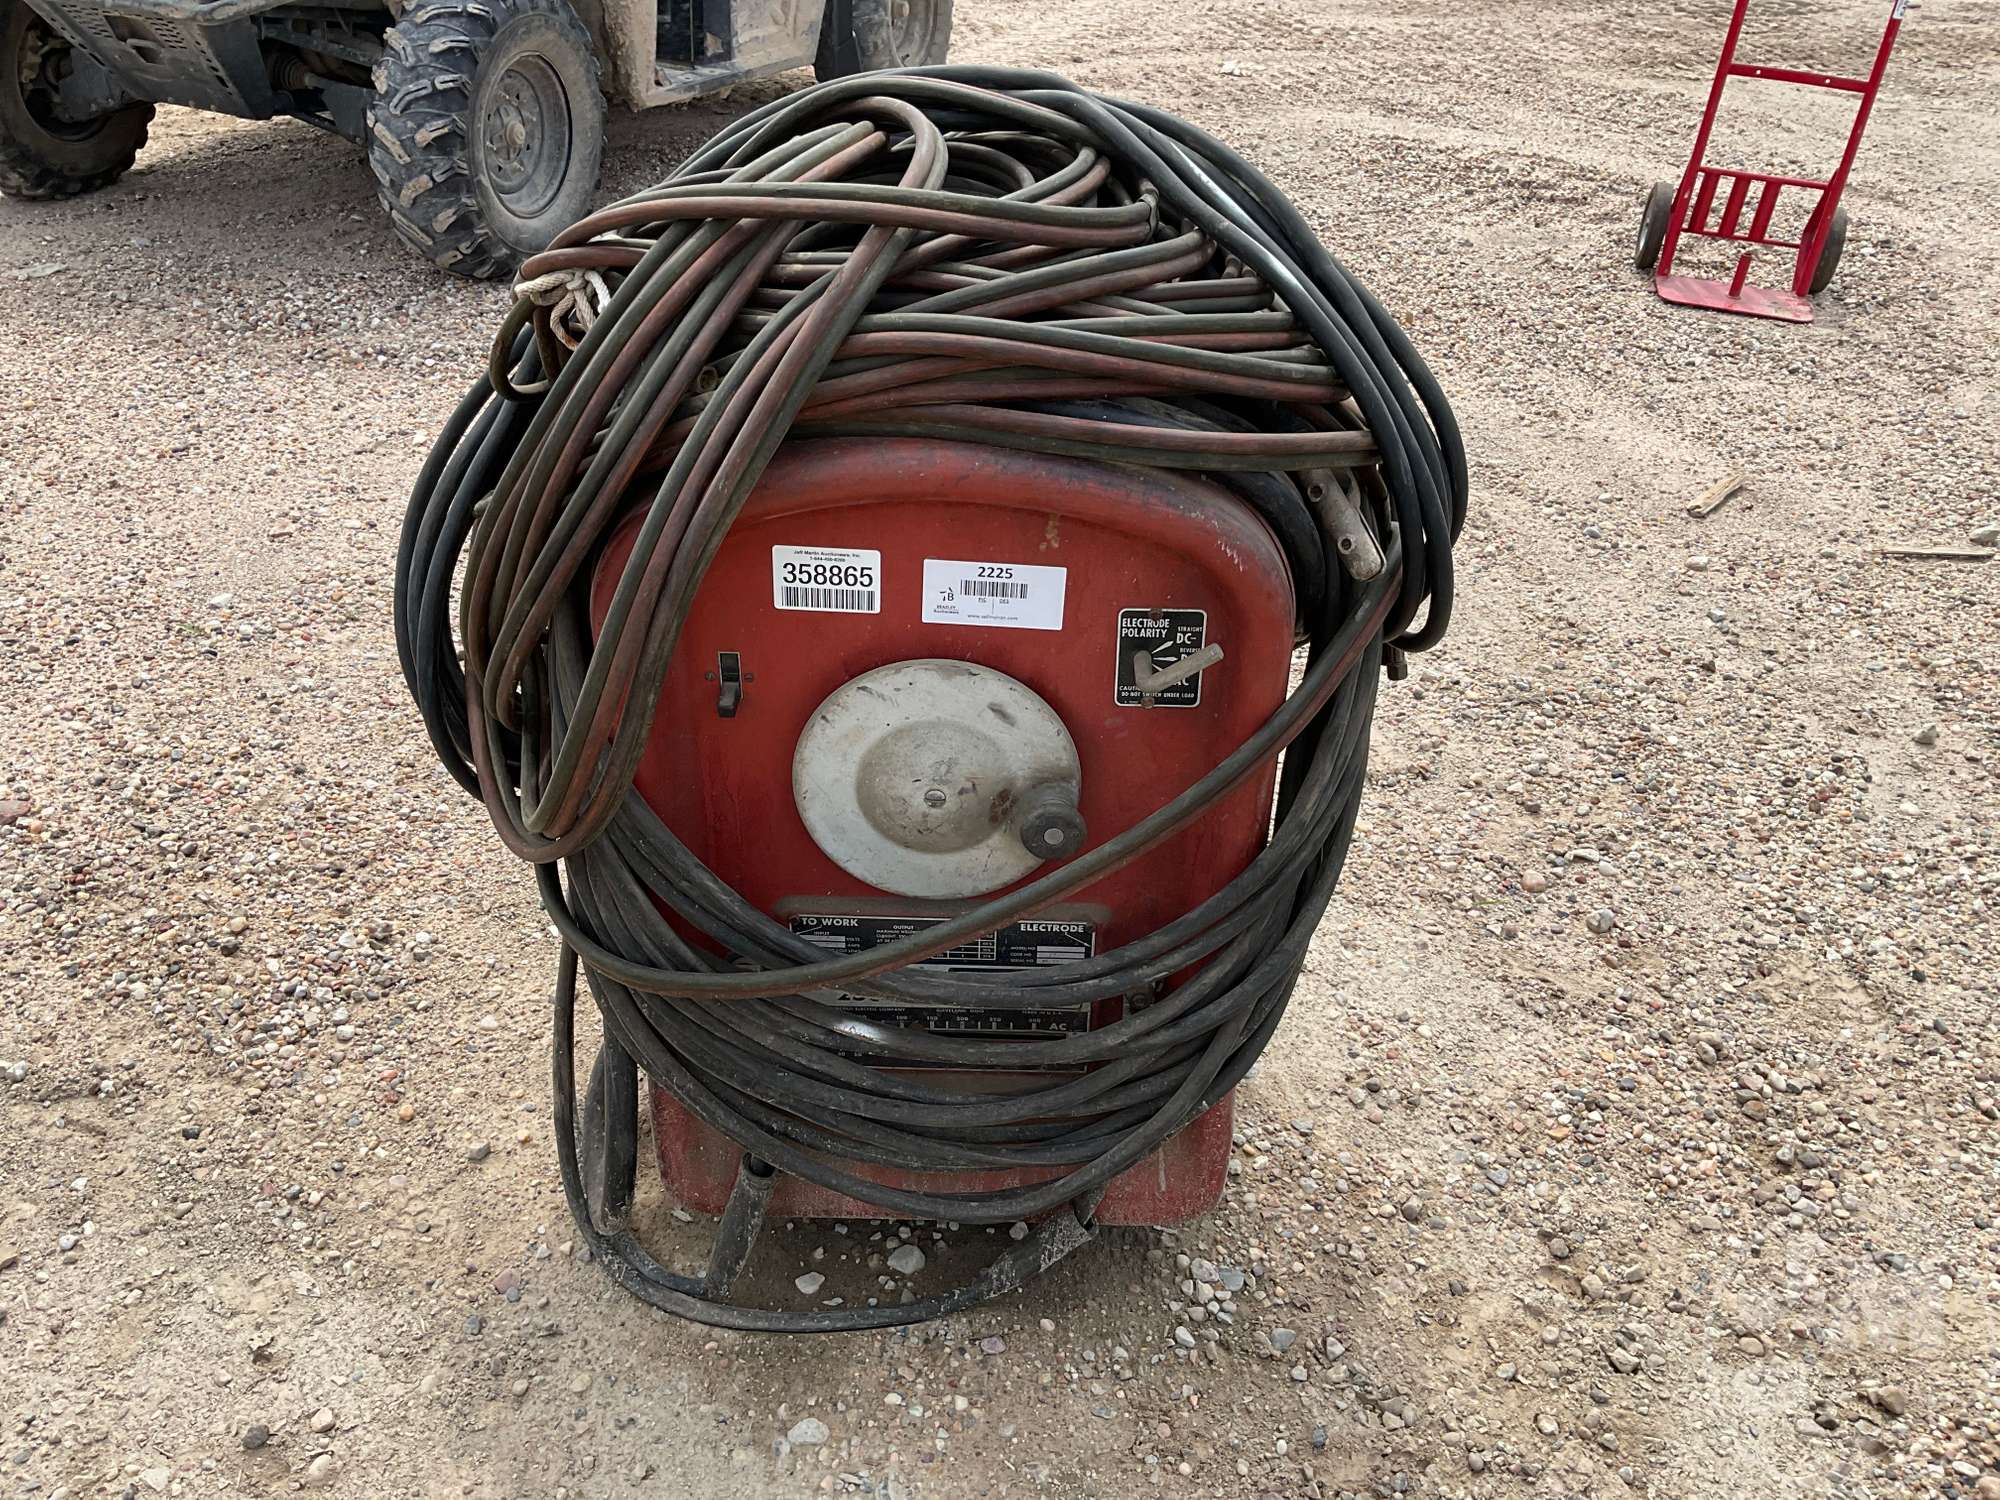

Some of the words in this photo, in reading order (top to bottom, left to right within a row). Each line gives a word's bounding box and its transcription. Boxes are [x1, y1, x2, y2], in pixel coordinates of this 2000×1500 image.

[782, 562, 873, 587] 358865
[977, 566, 1013, 579] 2225
[1122, 618, 1170, 628] ELECTRODE
[1121, 628, 1167, 638] POLARITY
[801, 917, 818, 926] TO
[821, 918, 859, 927] WORK
[1020, 923, 1085, 933] ELECTRODE
[1049, 1022, 1068, 1031] AC
